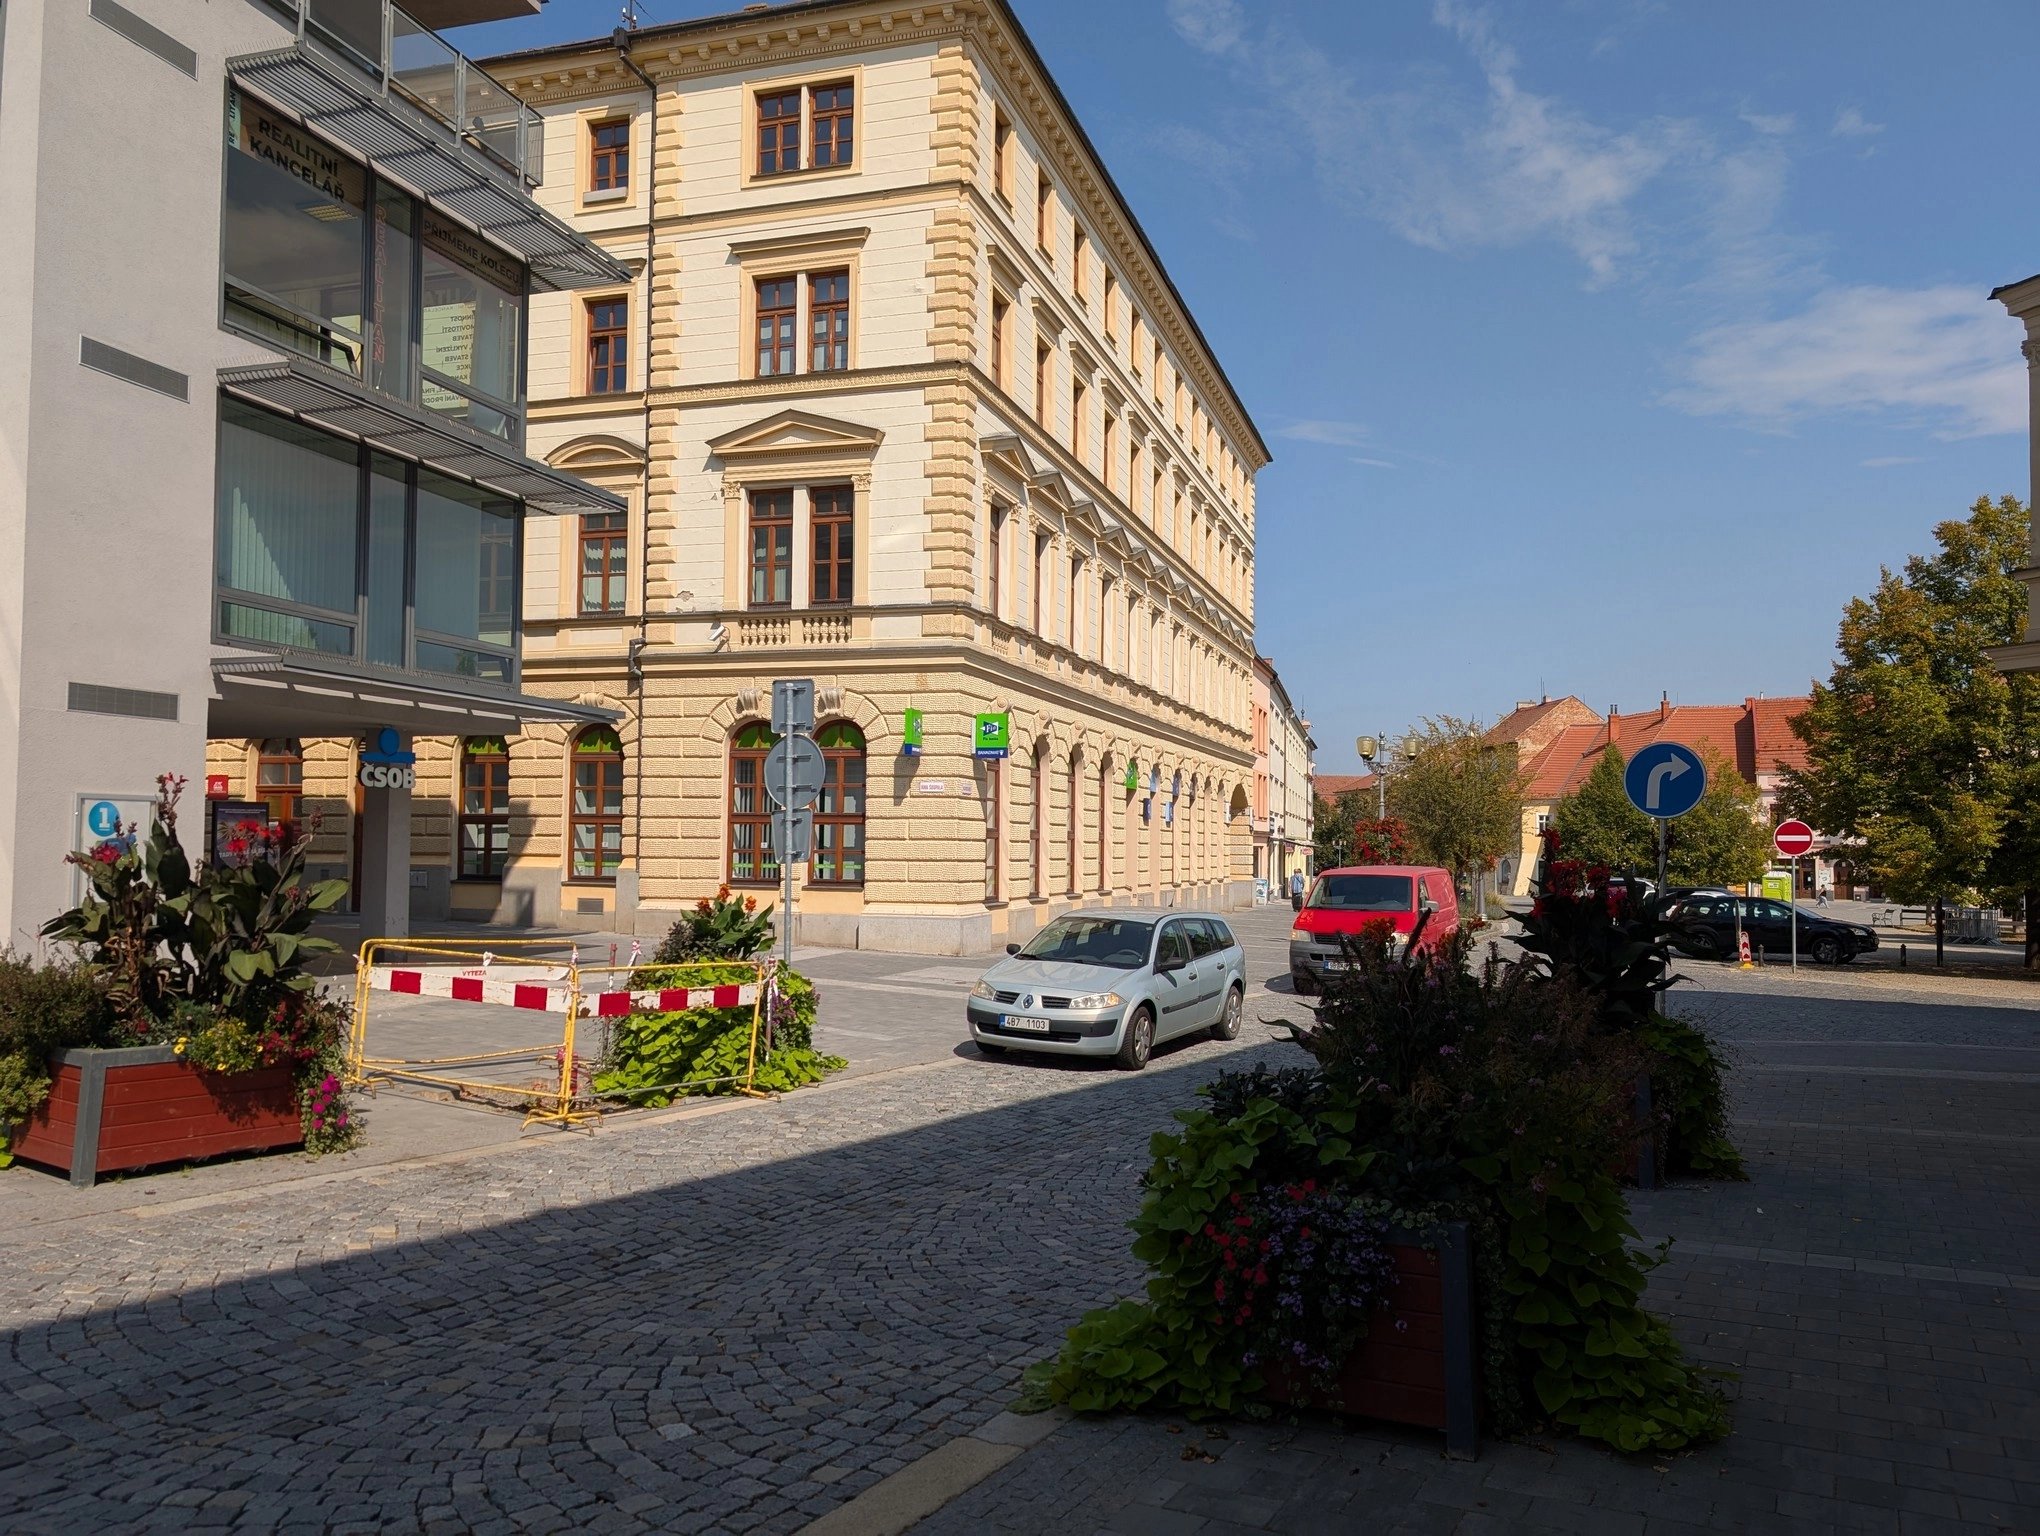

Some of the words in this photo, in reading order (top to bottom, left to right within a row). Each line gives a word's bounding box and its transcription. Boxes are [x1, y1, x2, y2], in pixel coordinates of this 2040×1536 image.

[249, 135, 345, 203] KANCELÁŘ
[258, 117, 339, 178] REALITNÍ
[373, 205, 386, 364] REALITAN
[361, 761, 416, 789] ČSOB
[1026, 1019, 1045, 1030] 1103
